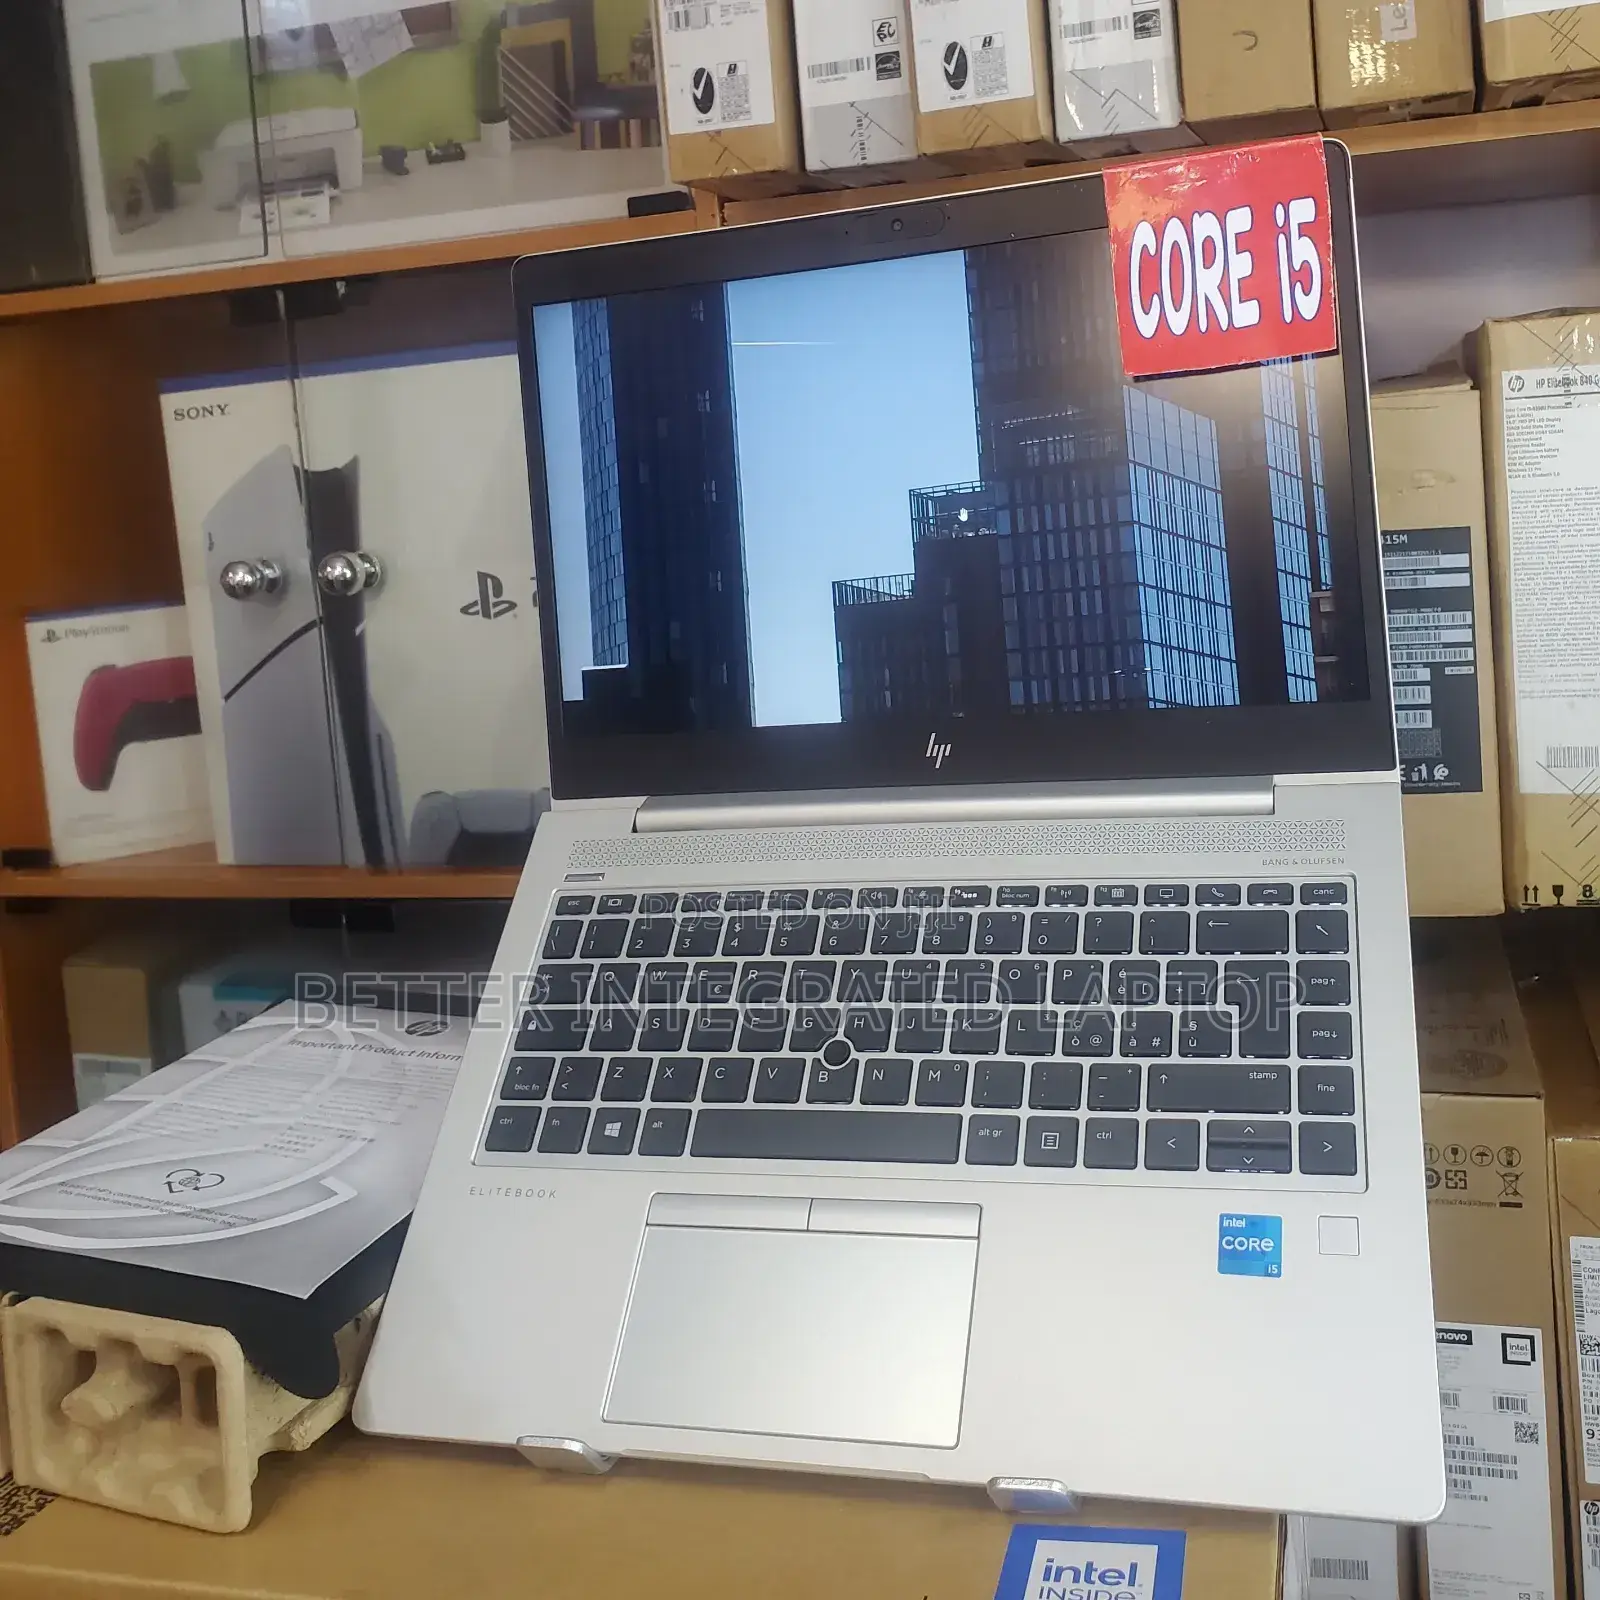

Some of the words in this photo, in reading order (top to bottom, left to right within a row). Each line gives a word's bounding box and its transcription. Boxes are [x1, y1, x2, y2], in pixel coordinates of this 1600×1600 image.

[1130, 205, 1260, 339] CORE
[1274, 196, 1322, 324] i5
[1535, 378, 1546, 389] HP
[1580, 374, 1592, 386] 840
[173, 404, 229, 421] SONY
[64, 624, 130, 638] PlayStation
[925, 732, 952, 769] hp
[1313, 887, 1334, 895] canc
[1582, 884, 1593, 898] 8
[783, 922, 793, 932] %
[986, 918, 992, 929] )
[1095, 917, 1102, 927] ?
[734, 922, 741, 933] $
[590, 940, 594, 949] 1
[635, 939, 644, 949] 2
[682, 939, 691, 948] 3
[731, 938, 739, 947] 4
[780, 938, 788, 947] 5
[829, 936, 837, 946] 6
[880, 935, 889, 945] 7
[932, 935, 940, 945] 8
[984, 935, 994, 945] 9
[604, 971, 614, 982] Q
[652, 971, 667, 981] W
[698, 970, 708, 981] E
[748, 970, 758, 980] R
[799, 970, 807, 979] T
[850, 969, 860, 979] Y
[901, 969, 912, 979] U
[1009, 969, 1020, 980] O
[1063, 969, 1073, 980] P
[1119, 968, 1126, 978] é
[714, 985, 723, 994] €
[1118, 985, 1126, 995] è
[602, 1018, 613, 1030] A
[652, 1018, 660, 1028] S
[700, 1018, 711, 1029] D
[751, 1018, 760, 1028] F
[803, 1018, 814, 1028] G
[854, 1018, 865, 1028] H
[907, 1018, 916, 1029] J
[962, 1018, 972, 1030] K
[1018, 1019, 1026, 1031] L
[1189, 1021, 1198, 1031] §
[1071, 1035, 1080, 1046] ò
[1090, 1035, 1103, 1046] @
[1129, 1036, 1137, 1046] à
[1151, 1037, 1161, 1047] #
[1189, 1036, 1197, 1046] ù
[288, 1039, 358, 1050] Important
[360, 1043, 417, 1057] Product
[613, 1067, 624, 1078] Z
[663, 1067, 675, 1079] X
[715, 1068, 726, 1079] C
[767, 1068, 778, 1079] V
[818, 1071, 828, 1083] B
[872, 1069, 884, 1080] N
[928, 1070, 941, 1082] M
[1249, 1071, 1278, 1080] stamp
[514, 1083, 524, 1091] bloc
[1317, 1084, 1335, 1092] fine
[500, 1117, 513, 1125] ctrl
[551, 1118, 560, 1126] fn
[652, 1120, 663, 1129] alt
[978, 1128, 990, 1136] alt
[992, 1129, 1003, 1138] gr
[1096, 1131, 1112, 1140] ctrl
[469, 1186, 557, 1199] ELITEBOOK
[1223, 1217, 1246, 1228] intel
[1268, 1264, 1278, 1274] i5
